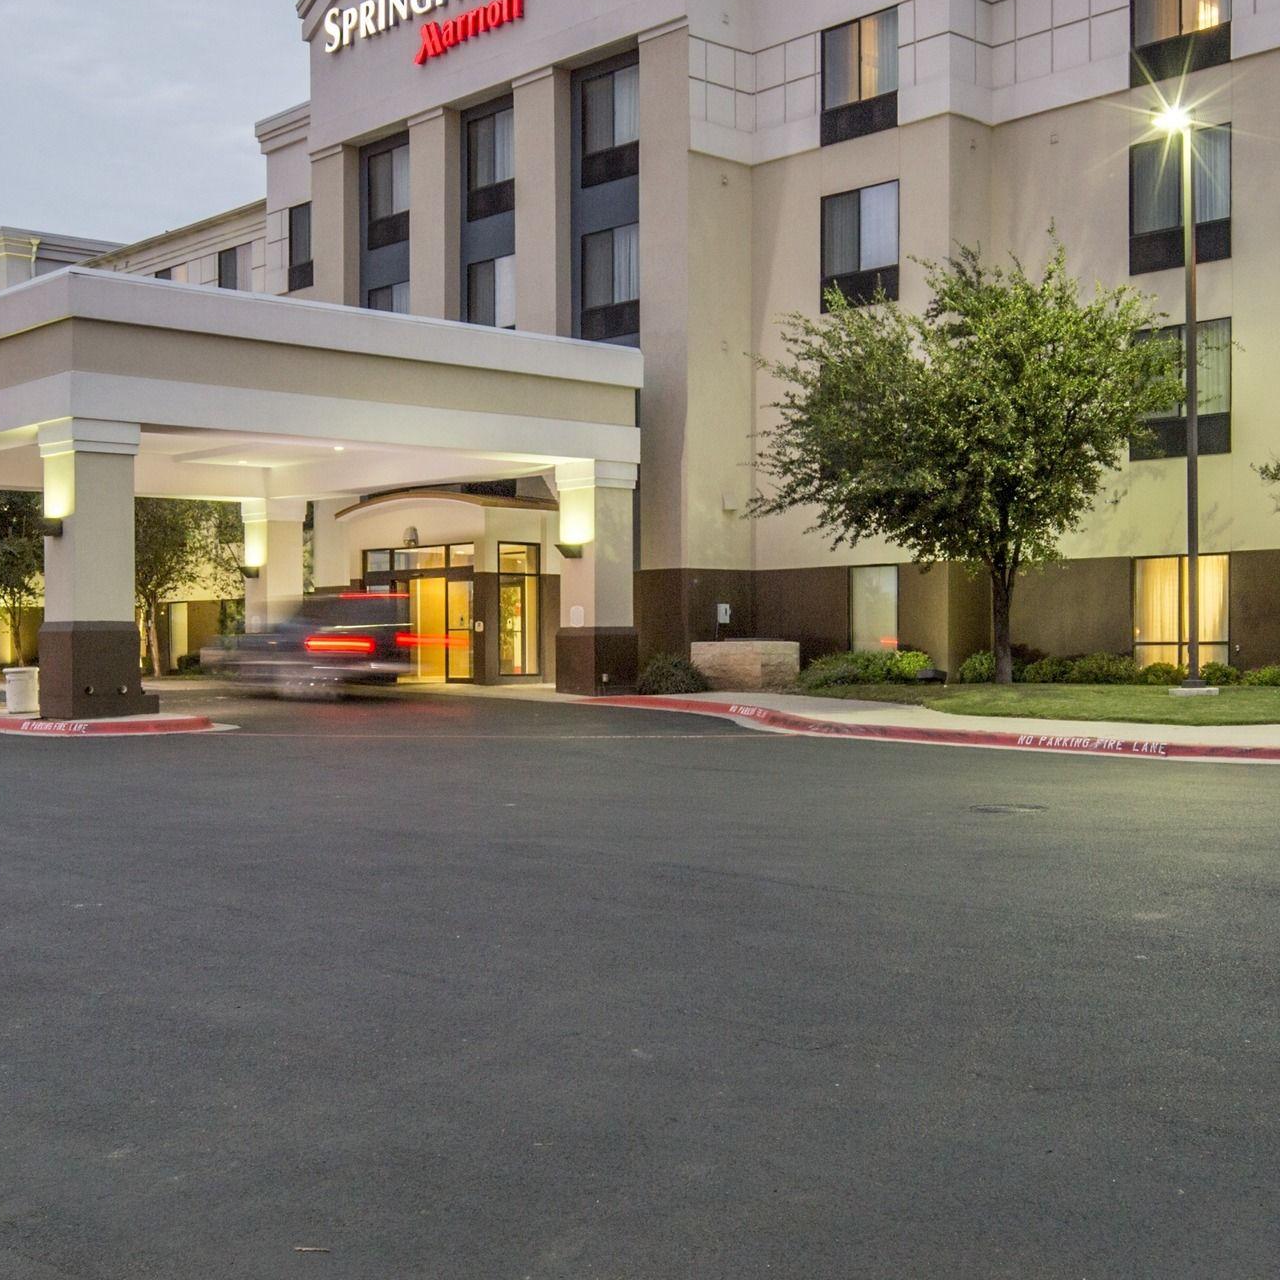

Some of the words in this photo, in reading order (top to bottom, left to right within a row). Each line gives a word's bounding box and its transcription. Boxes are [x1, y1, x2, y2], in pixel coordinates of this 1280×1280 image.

[1017, 735, 1033, 745] NO
[1038, 736, 1090, 748] PARKING
[1094, 738, 1122, 751] FIRE
[1132, 741, 1167, 755] LANE
